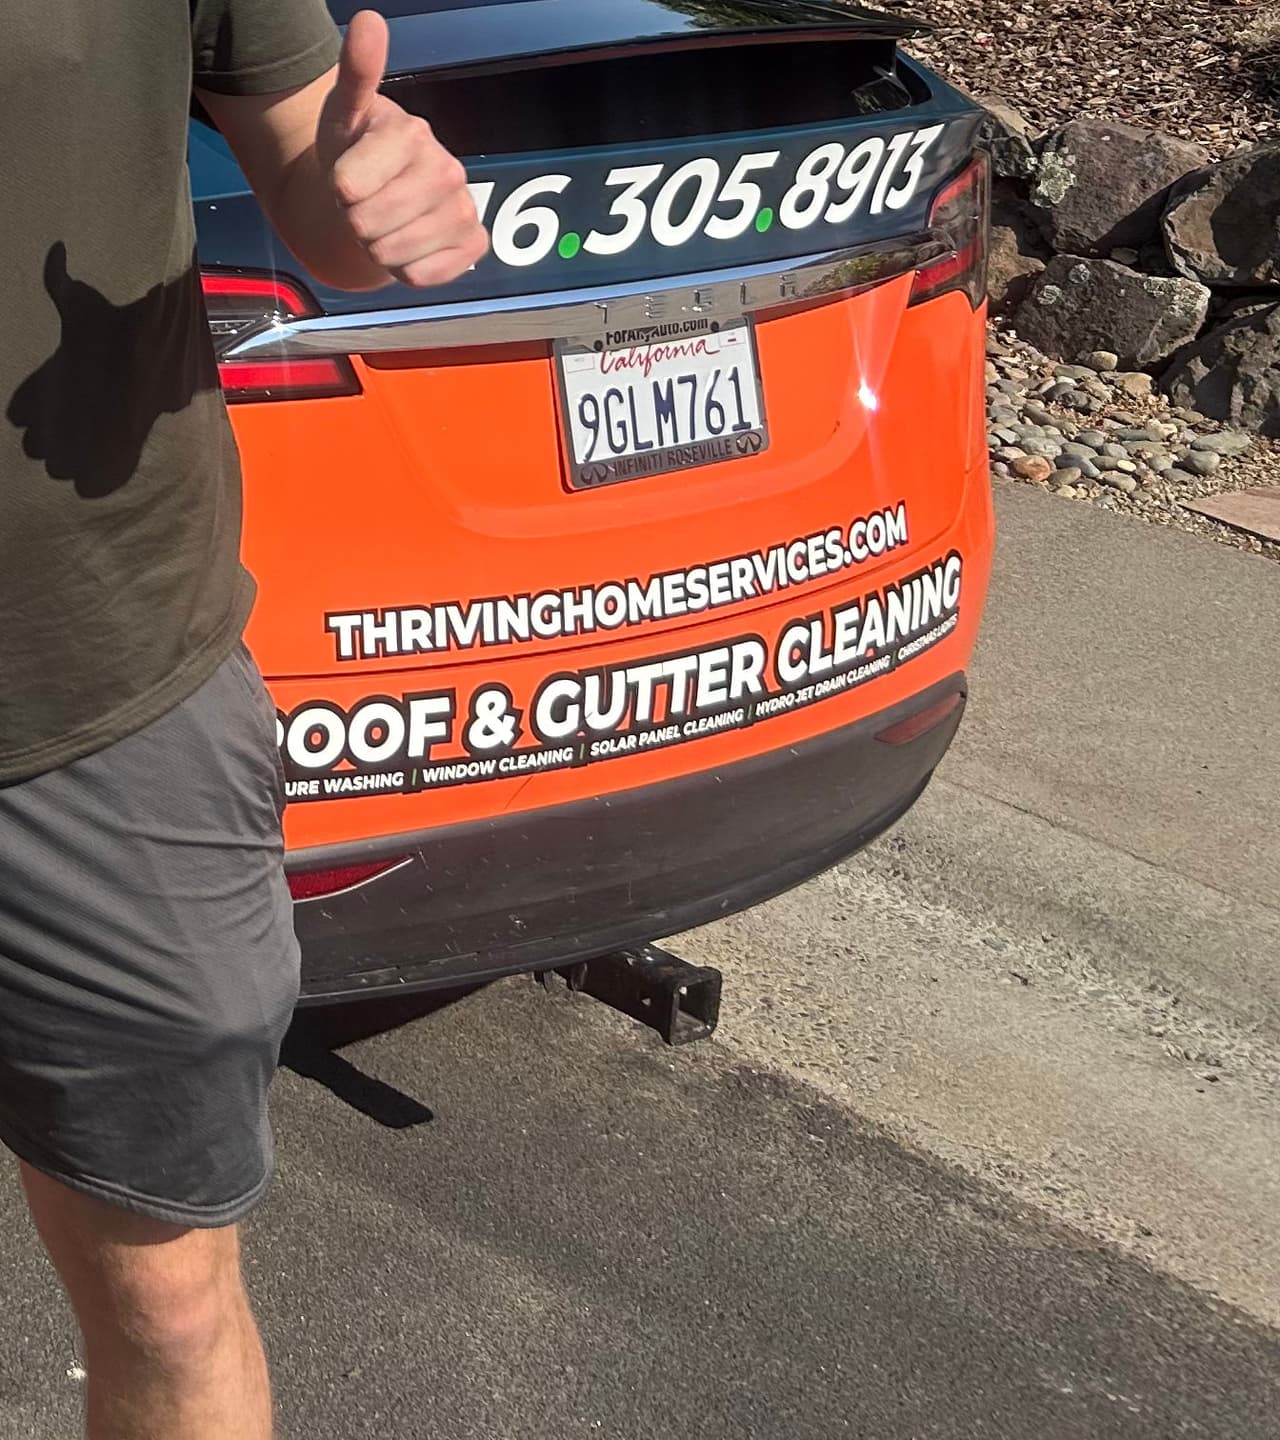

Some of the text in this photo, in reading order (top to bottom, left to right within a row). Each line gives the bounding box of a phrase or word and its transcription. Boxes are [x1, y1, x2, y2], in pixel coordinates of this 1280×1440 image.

[578, 366, 752, 464] 9GLM761
[599, 338, 721, 378] California
[613, 439, 733, 477] INFINITI ROSEVILLE
[328, 504, 908, 657] THRIVINGHOMESERVICES.COM
[276, 555, 961, 769] OOF & GUTTER CLEANING
[323, 771, 405, 794] WASHING
[422, 758, 497, 783] WINDOW
[498, 747, 574, 773] CLEANING
[590, 735, 637, 757] SOLAR
[639, 725, 681, 747] PANEL
[683, 708, 744, 736] CLEANING
[755, 692, 795, 717] HYDRO
[794, 684, 814, 704] JET
[815, 674, 847, 698] DRAIN
[846, 655, 891, 685] CLEANING
